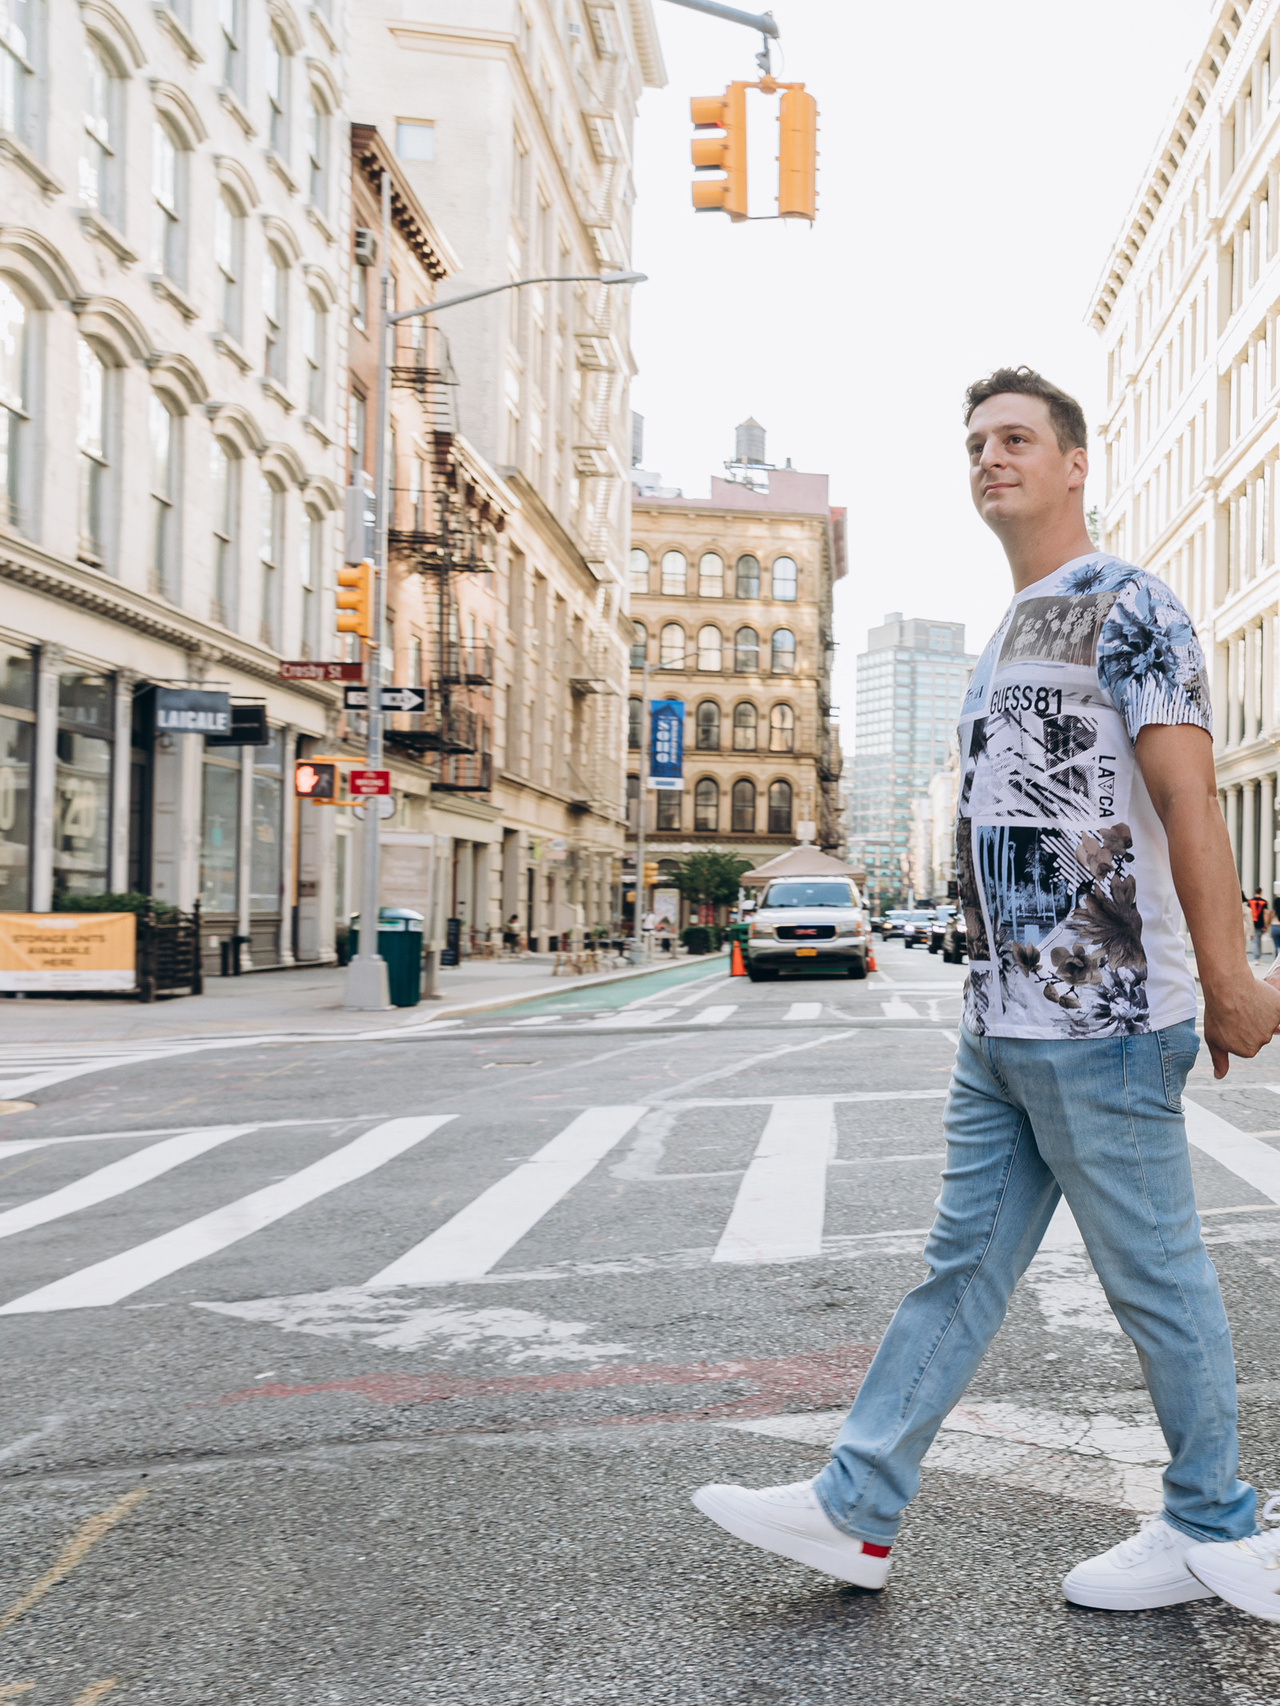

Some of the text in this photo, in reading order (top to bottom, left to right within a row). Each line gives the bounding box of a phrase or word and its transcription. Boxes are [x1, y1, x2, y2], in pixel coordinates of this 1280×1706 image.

[281, 664, 342, 680] Crosby St
[12, 934, 106, 943] STORAGE UNITS
[27, 946, 91, 955] AVAILABLE
[42, 959, 74, 967] HERE
